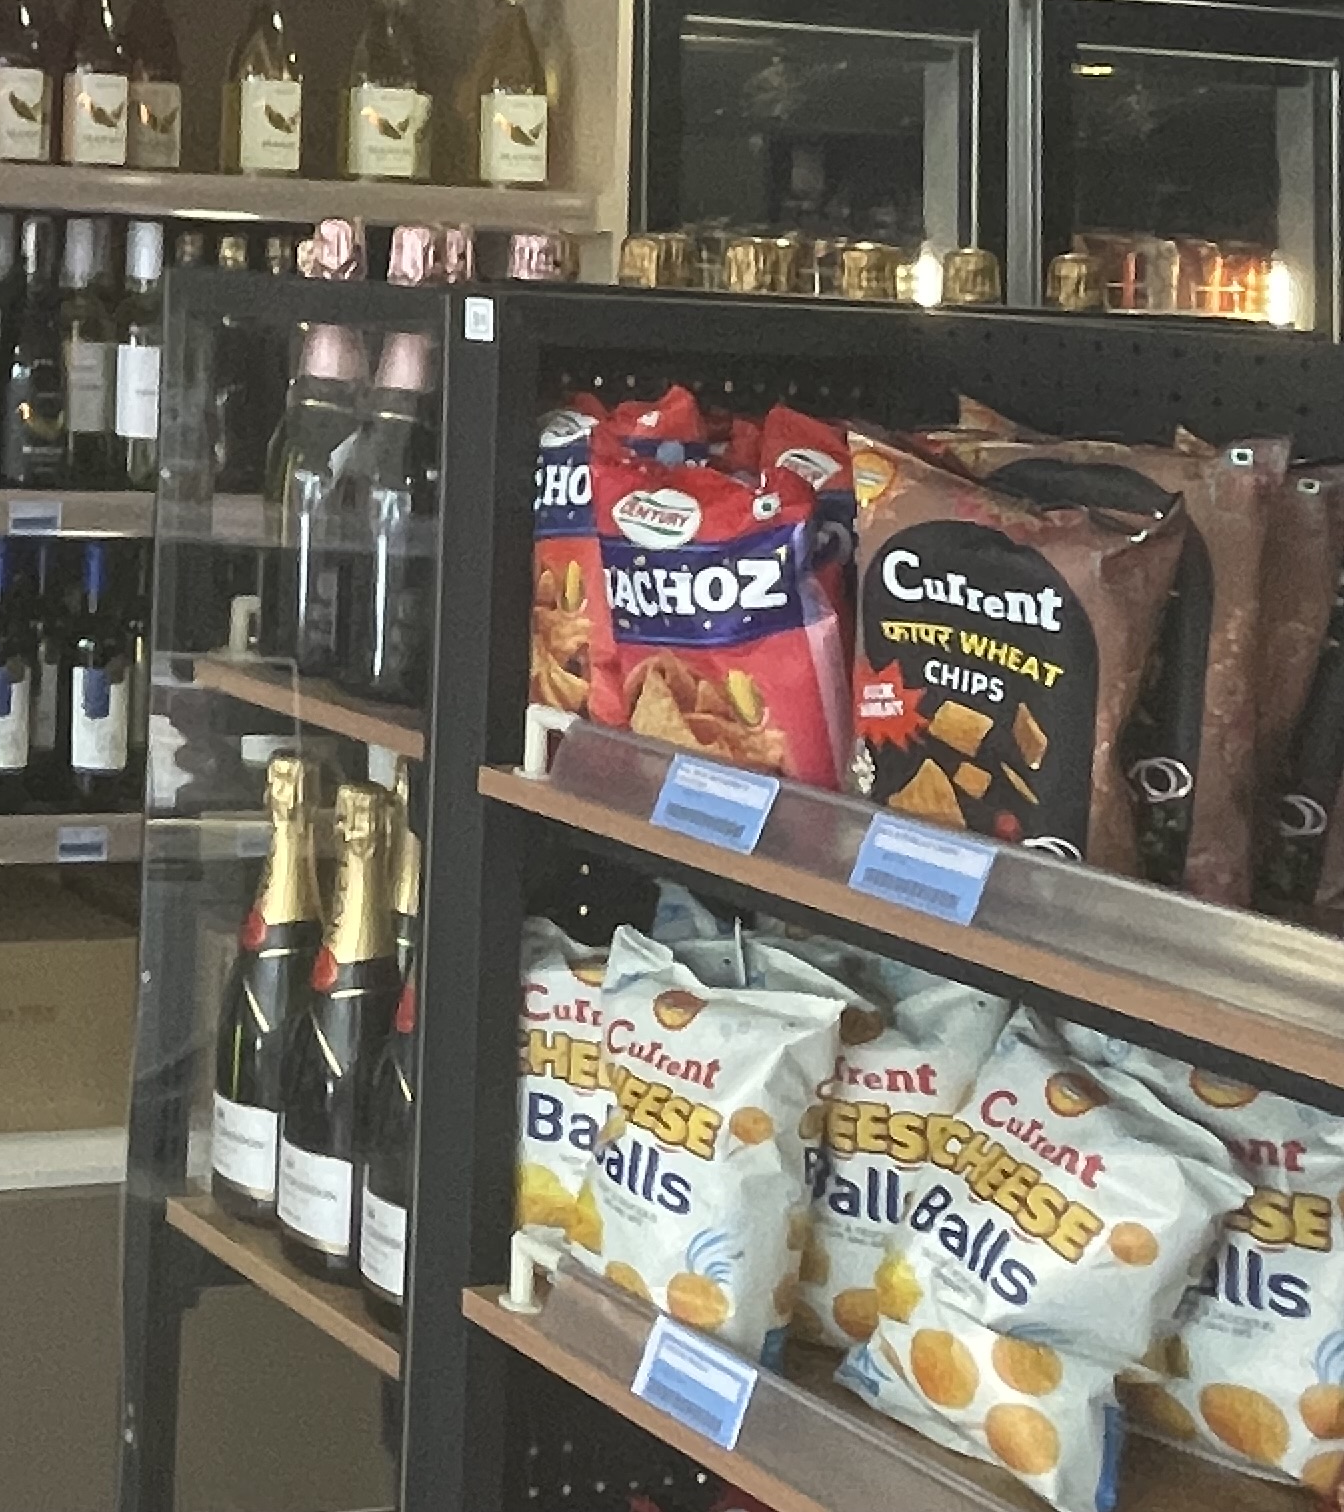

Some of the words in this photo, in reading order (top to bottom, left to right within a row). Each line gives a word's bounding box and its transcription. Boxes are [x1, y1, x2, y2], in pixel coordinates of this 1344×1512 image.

[619, 499, 689, 529] CENTURY
[882, 549, 1062, 632] Current
[923, 658, 1004, 702] CHIPS
[960, 630, 1064, 688] WHEAT
[607, 1019, 721, 1089] Current
[980, 1090, 1106, 1188] Current
[597, 1140, 692, 1214] alls
[928, 1118, 1105, 1264] CHEESE
[910, 1184, 1037, 1306] Balls
